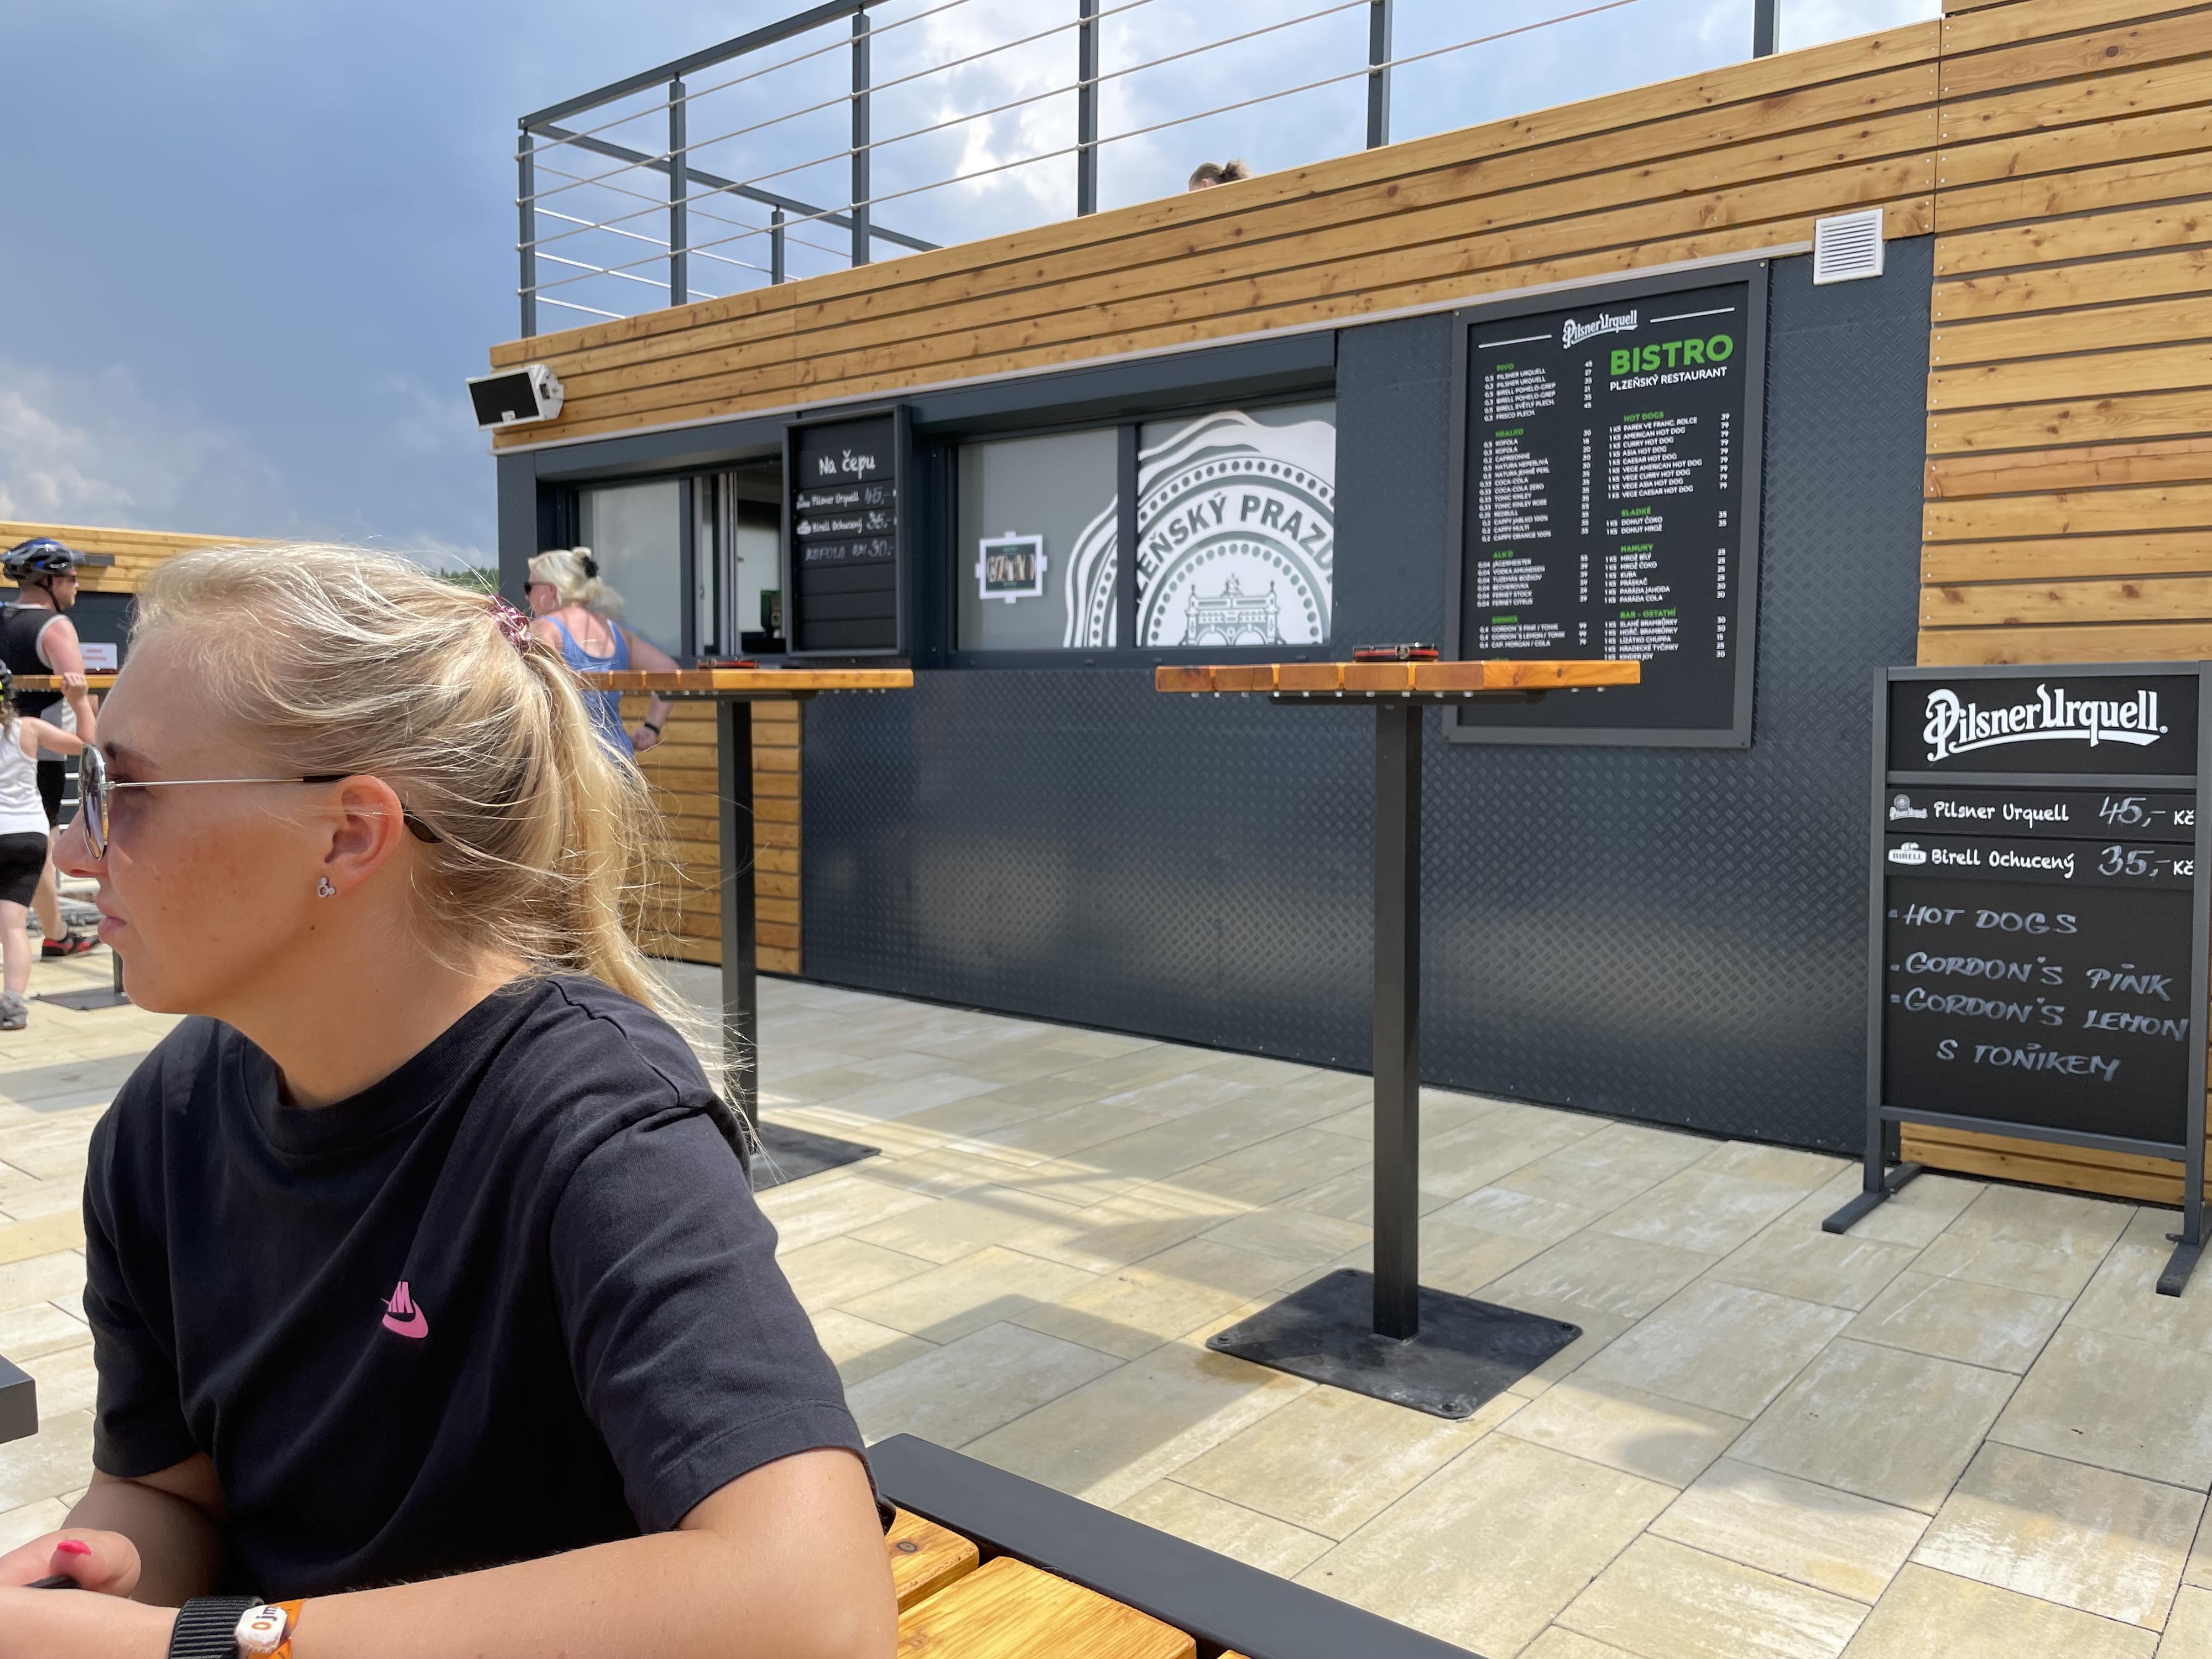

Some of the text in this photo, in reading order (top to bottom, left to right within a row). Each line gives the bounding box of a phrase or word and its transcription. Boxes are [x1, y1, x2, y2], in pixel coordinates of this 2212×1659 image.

[1562, 309, 1639, 349] Pilsner Urquell
[1610, 334, 1734, 375] BISTRO
[1610, 366, 1727, 391] PLZEŇSKÝ RESTAURANT
[1642, 410, 1664, 420] DOGS
[1623, 430, 1655, 440] AMERICAN
[1623, 440, 1644, 448] CURRY
[818, 449, 876, 479] Na čepu
[1623, 456, 1646, 465] CAESAR
[1639, 462, 1671, 471] AMERICAN
[1639, 471, 1660, 480] CURRY
[1639, 488, 1663, 497] CAESAR
[1621, 518, 1644, 526] DONUT
[1645, 515, 1663, 524] ČOKO
[1621, 526, 1644, 534] DONUT
[1240, 494, 1333, 584] PRAZD
[805, 546, 845, 561] KOFOLA
[1643, 607, 1676, 618] OSTATNÍ
[1923, 688, 2041, 762] Pilsner
[1934, 801, 1995, 820] Pilsner
[2002, 802, 2070, 829] Urquell
[2174, 810, 2194, 826] Kč
[1931, 848, 1981, 866] Birell
[1989, 850, 2075, 879] Ochucený
[2173, 859, 2194, 876] Kč
[1902, 904, 2077, 934] HOT DOGS
[2086, 963, 2173, 1001] PINK
[2082, 1009, 2189, 1042] LEMON
[1937, 1040, 2121, 1081] S TONIKEM
